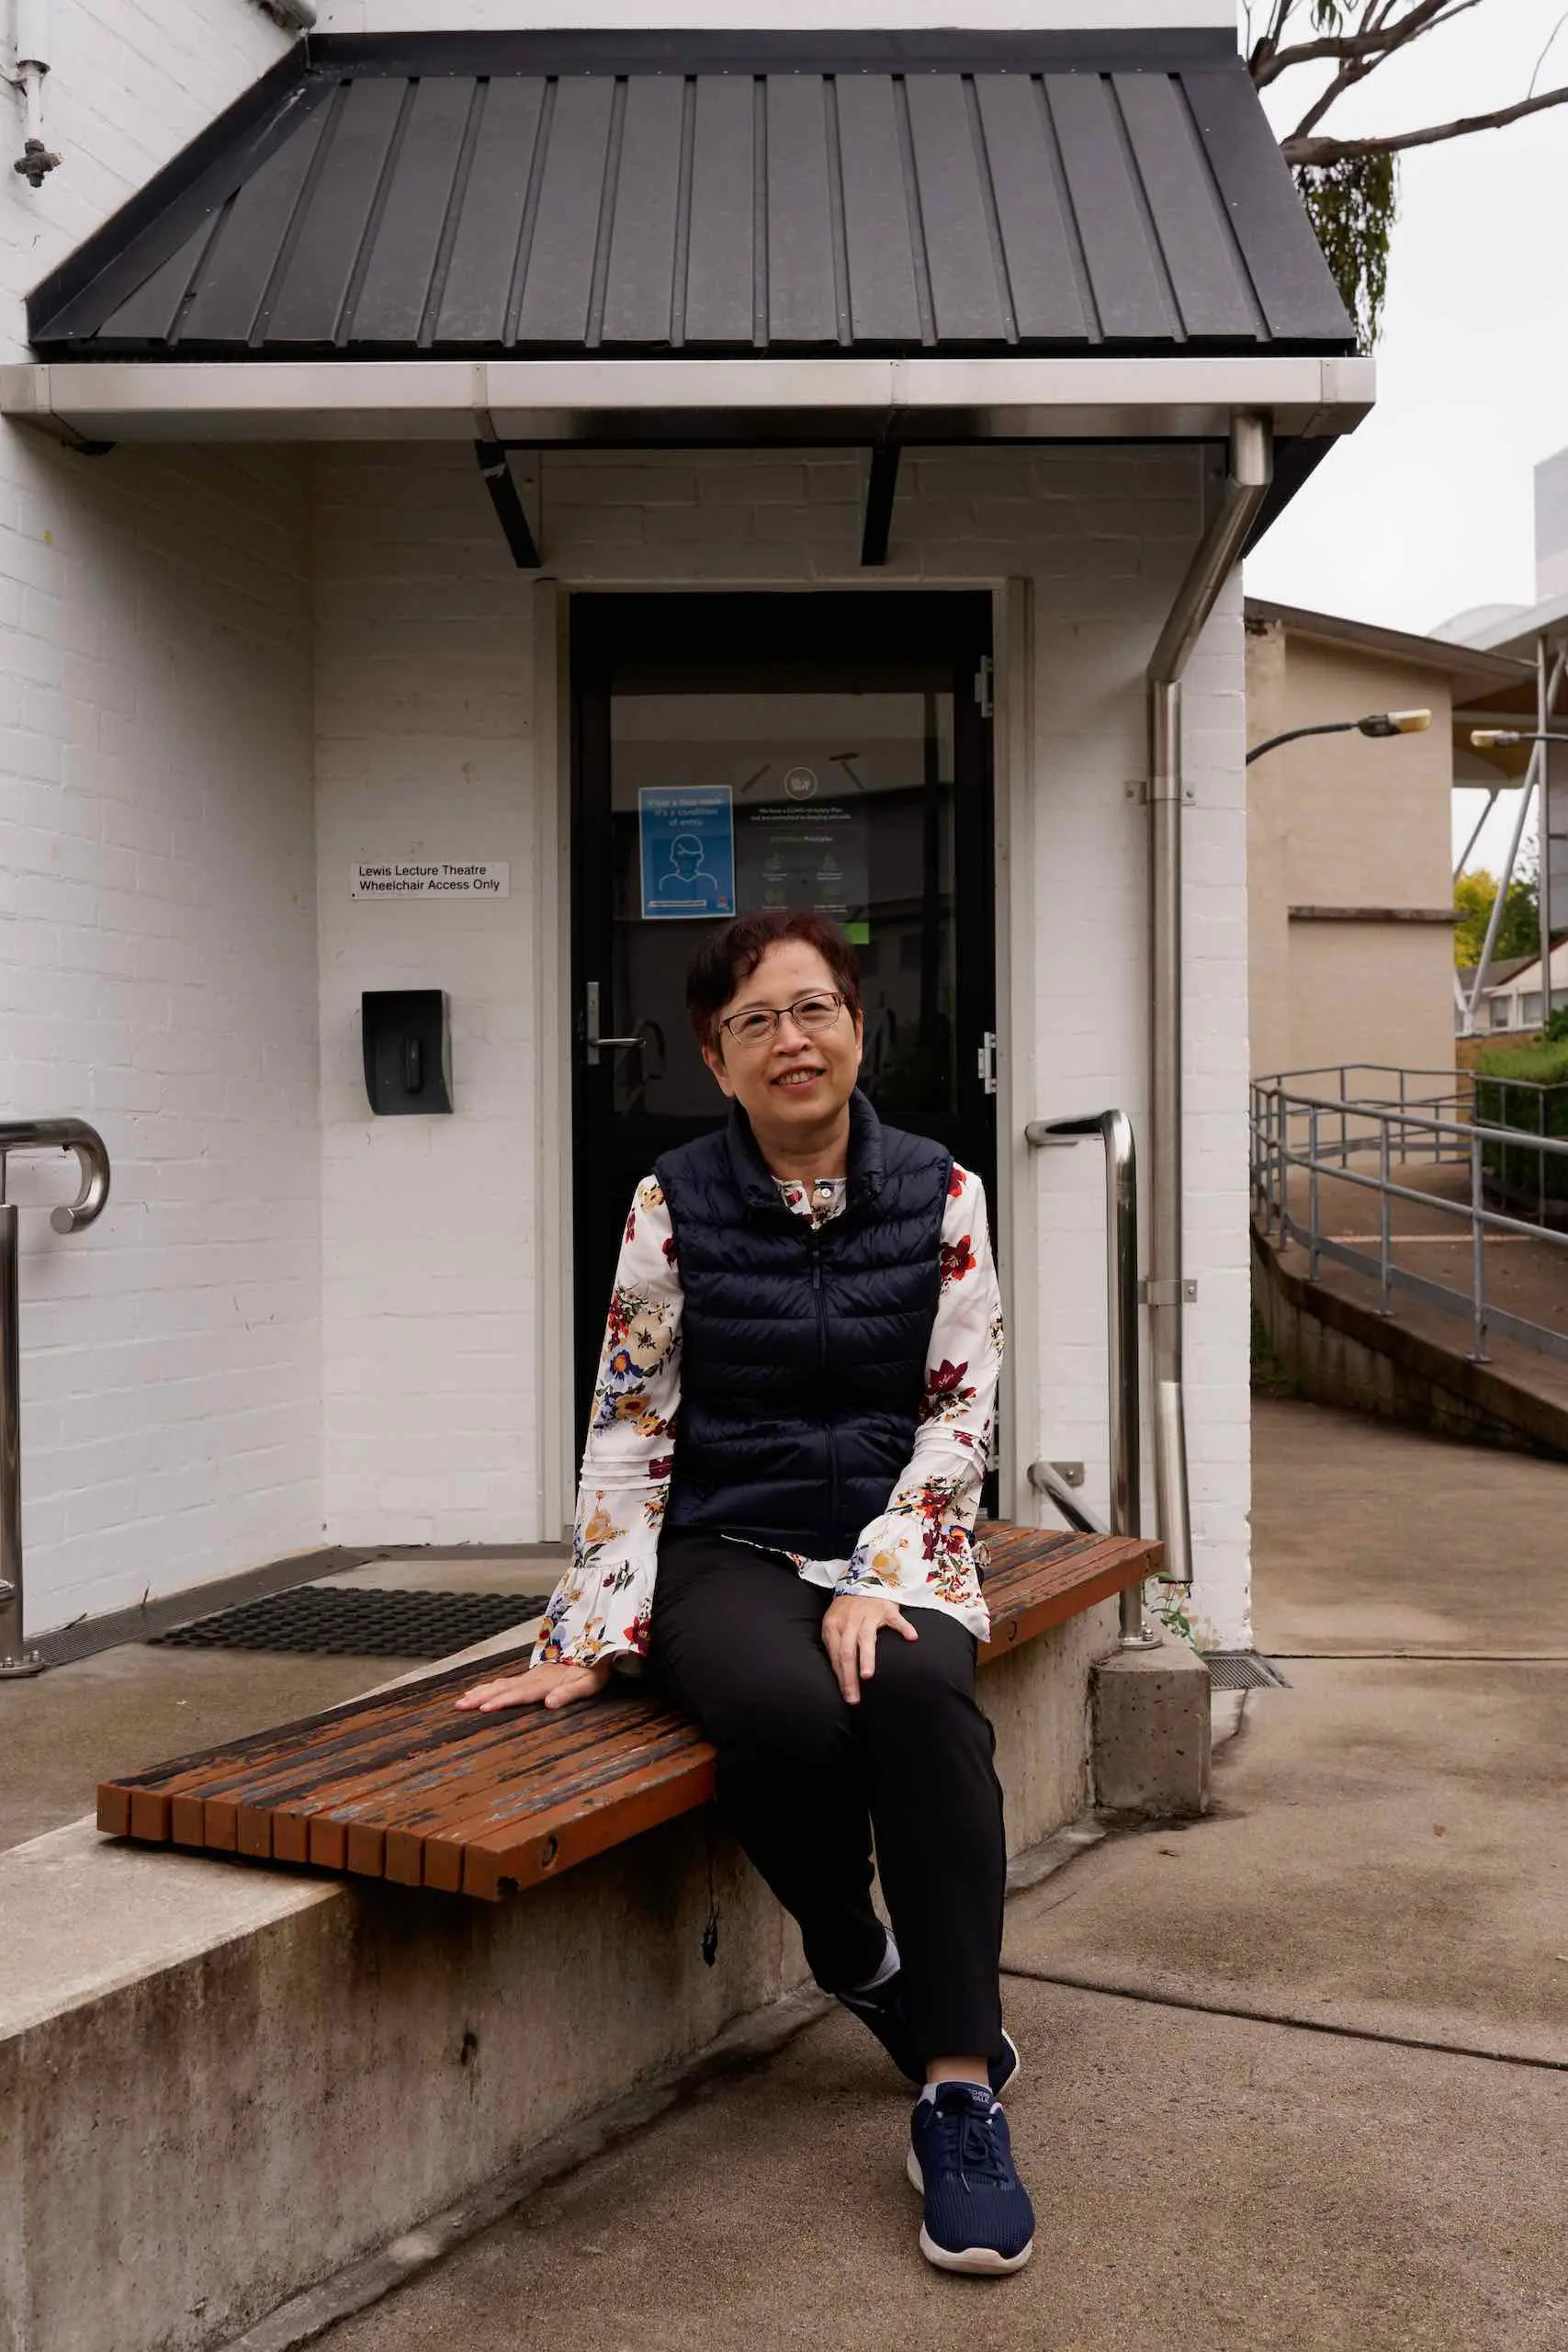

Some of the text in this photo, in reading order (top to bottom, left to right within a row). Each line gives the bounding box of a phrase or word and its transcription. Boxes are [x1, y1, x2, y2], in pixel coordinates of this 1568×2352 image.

[359, 865, 487, 876] Lewis Lecture Theatre
[359, 879, 500, 892] Wheelchair Access Only
